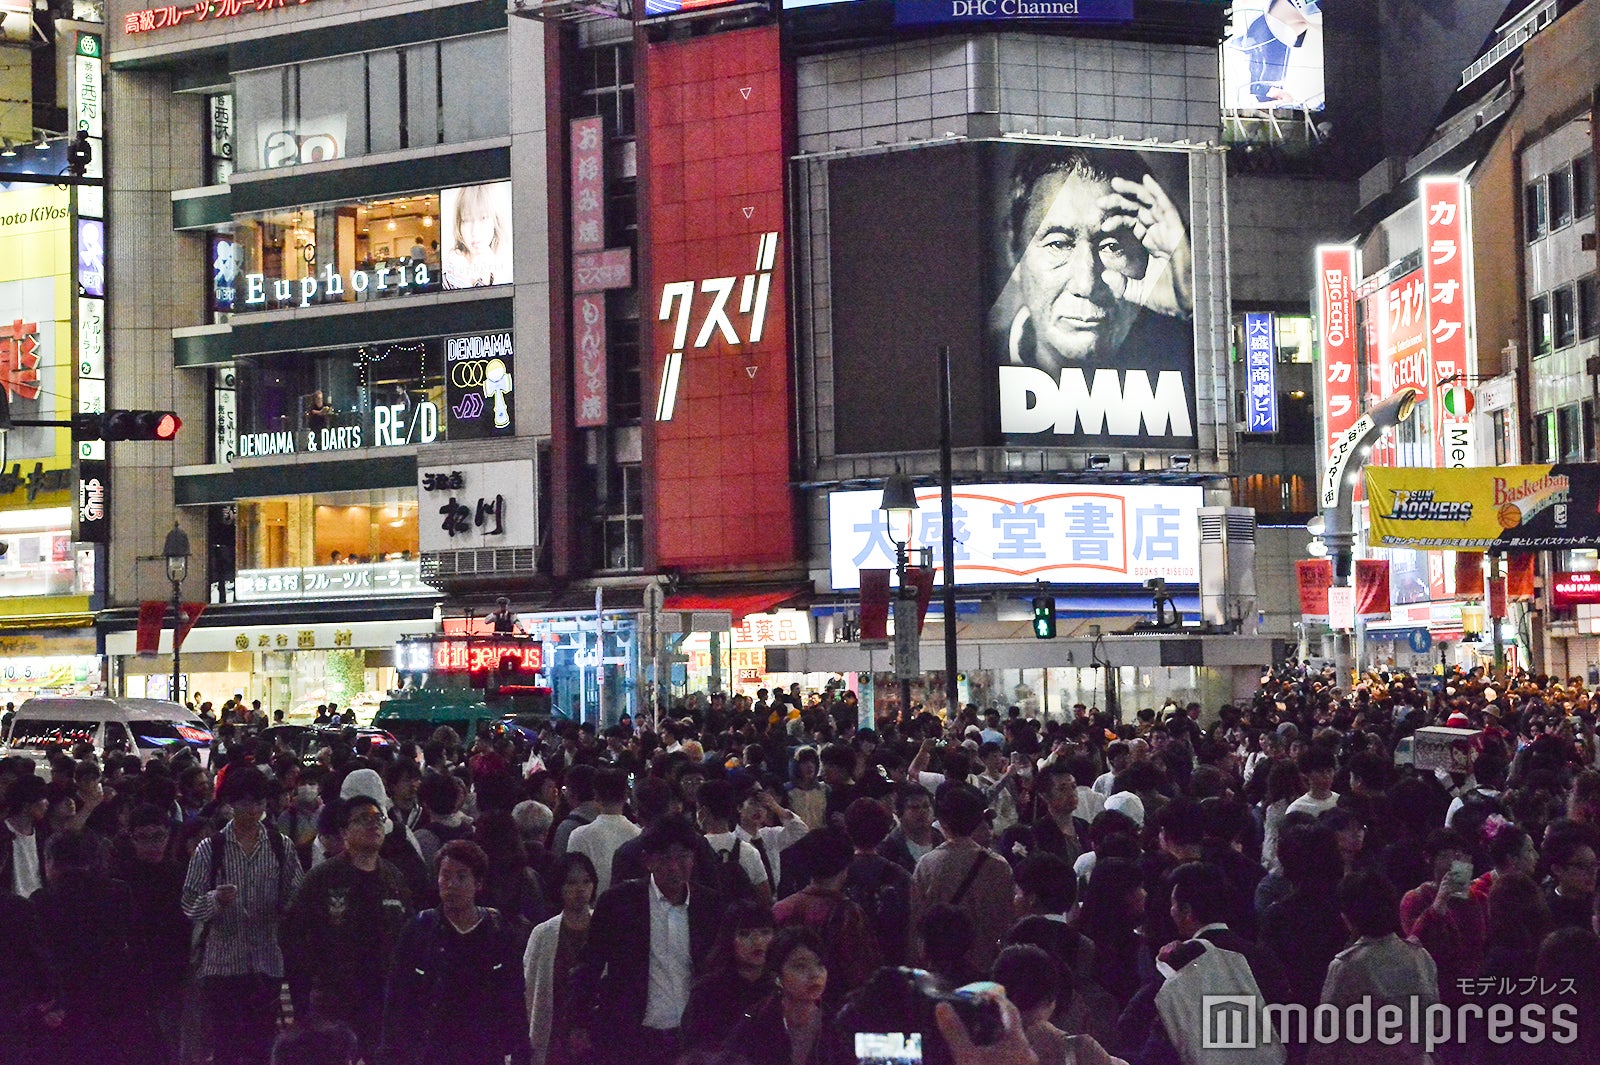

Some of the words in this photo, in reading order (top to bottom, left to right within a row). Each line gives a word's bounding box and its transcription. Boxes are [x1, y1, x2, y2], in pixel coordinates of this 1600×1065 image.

[952, 0, 996, 16] DHC
[1001, 0, 1079, 15] Channel
[245, 262, 430, 307] Euphoria
[1326, 269, 1342, 300] BIG
[1429, 200, 1462, 344] カラオケ
[1328, 304, 1345, 347] ECHO
[448, 332, 514, 361] DENDAMA
[1250, 319, 1272, 428] 大盛堂商事ビル
[999, 365, 1193, 437] DMM
[240, 430, 294, 457] DENDAMA
[308, 430, 317, 451] &
[321, 425, 361, 449] DARTS
[1325, 420, 1368, 505] 渋谷センター街
[1493, 474, 1569, 507] Basketball
[852, 502, 1181, 567] 大盛堂書店
[1135, 567, 1158, 576] BOOKS
[697, 652, 727, 667] TX
